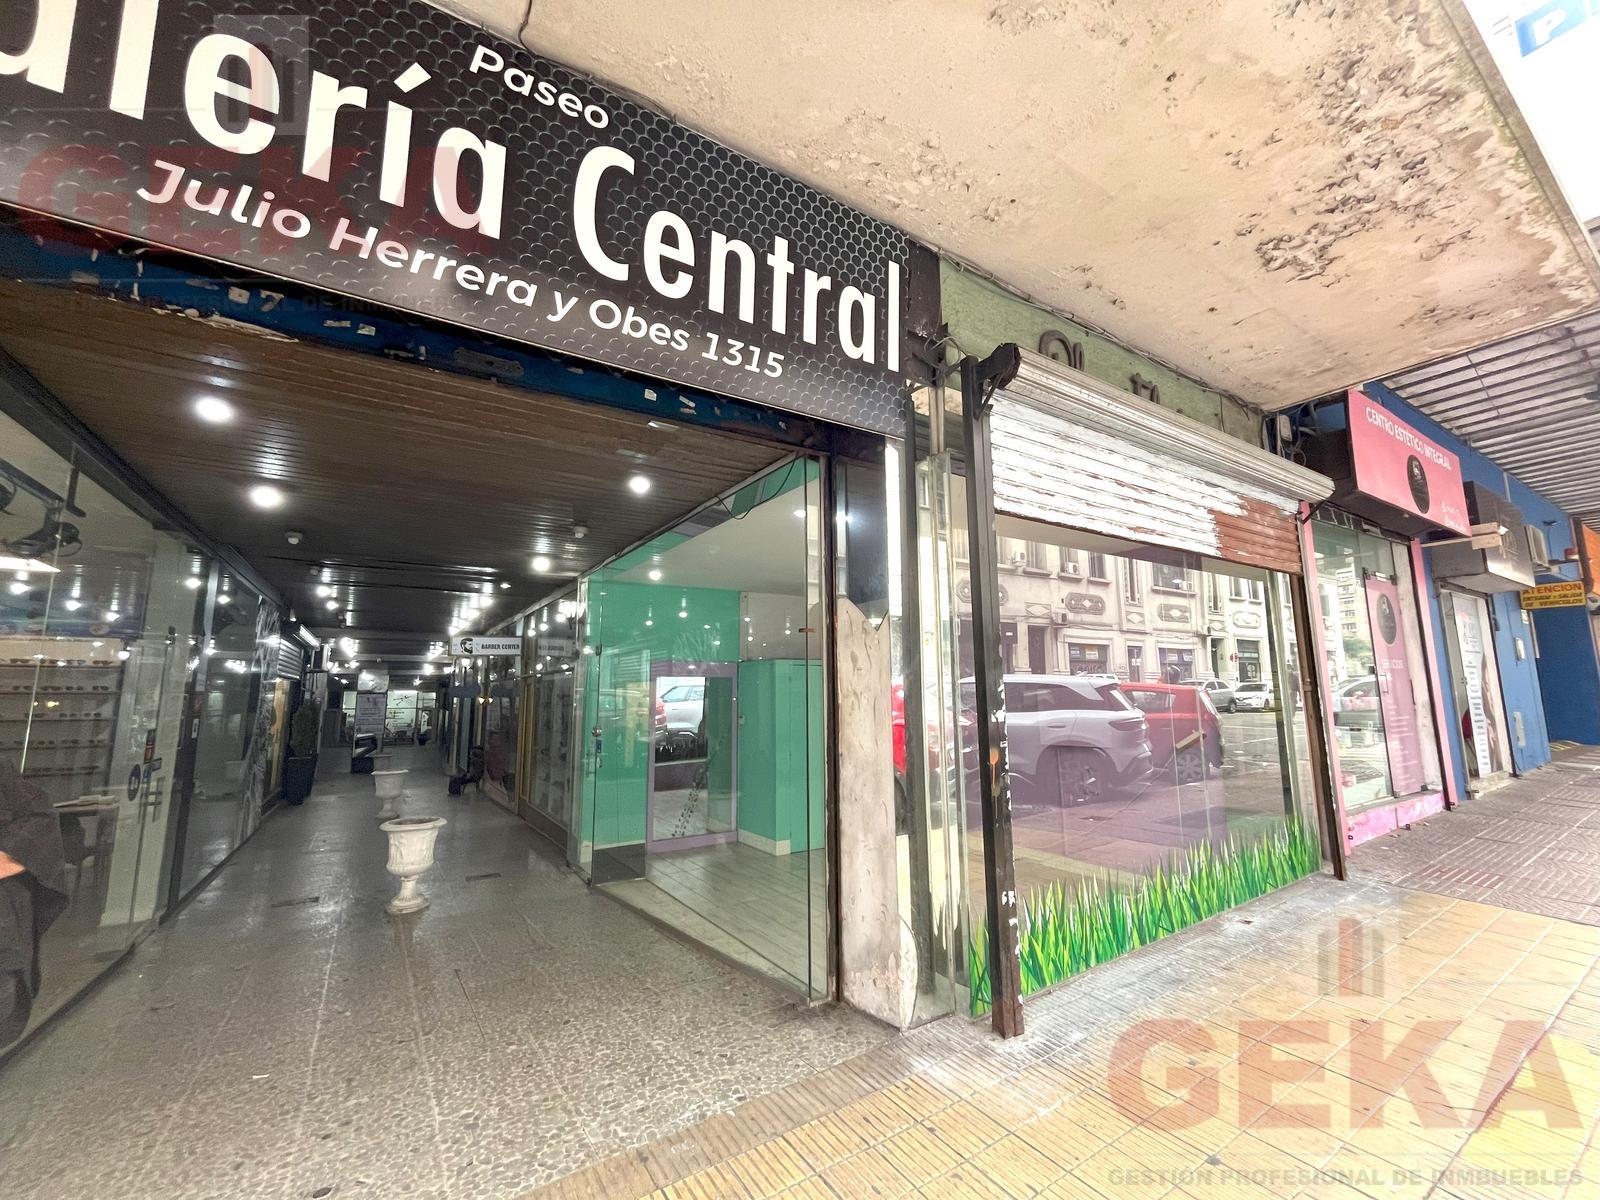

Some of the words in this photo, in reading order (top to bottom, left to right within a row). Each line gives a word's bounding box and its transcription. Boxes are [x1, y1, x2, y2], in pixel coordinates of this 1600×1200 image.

[469, 44, 609, 129] Paseo
[136, 159, 311, 239] Julio
[329, 217, 538, 308] Herrera
[545, 290, 579, 323] y
[588, 299, 691, 352] Obes
[701, 331, 786, 379] 1315
[573, 145, 900, 373] Central
[1365, 406, 1395, 436] CENTRO
[1423, 444, 1452, 470] INTEGRAL
